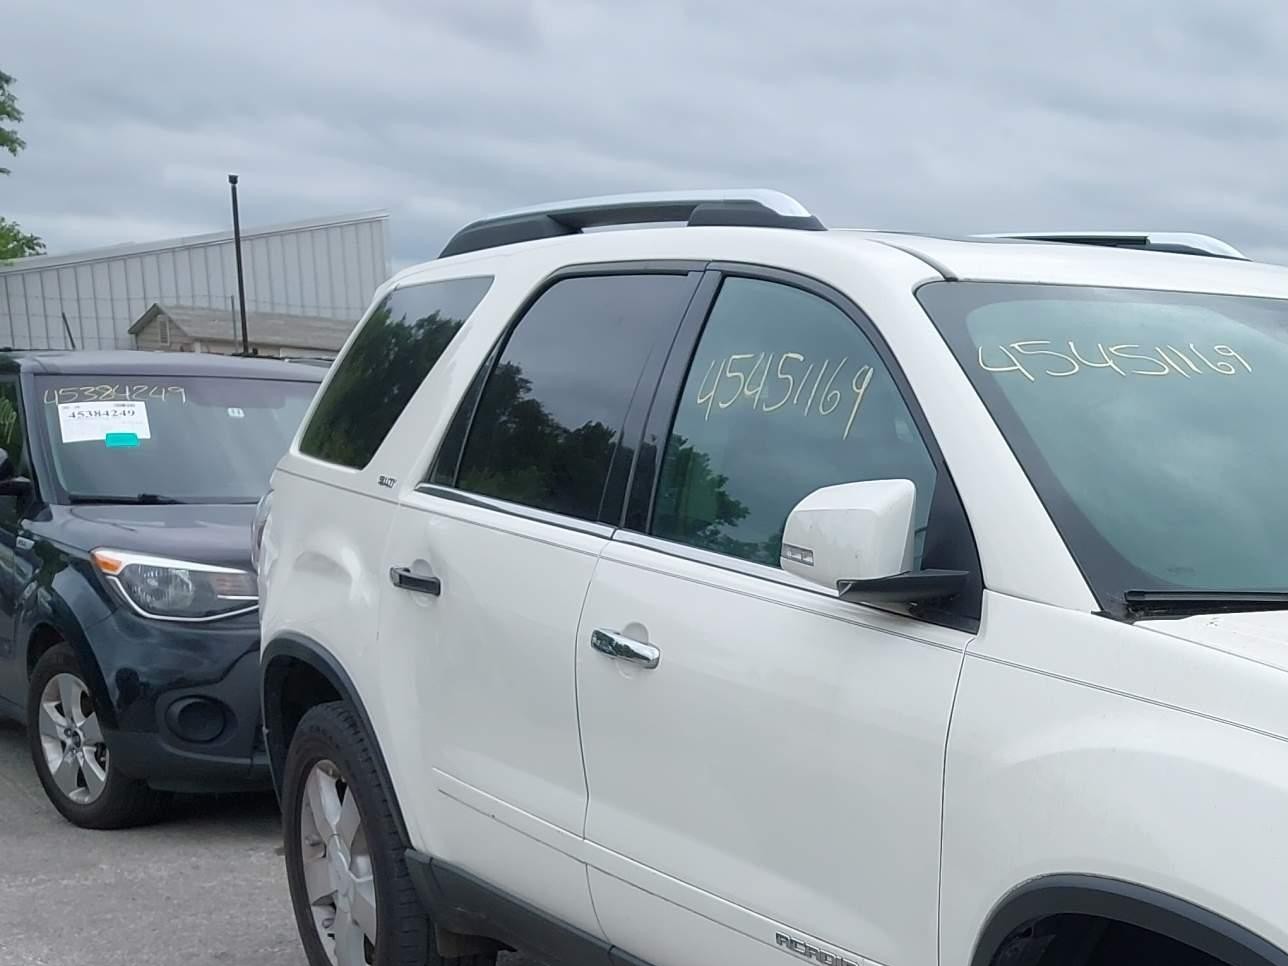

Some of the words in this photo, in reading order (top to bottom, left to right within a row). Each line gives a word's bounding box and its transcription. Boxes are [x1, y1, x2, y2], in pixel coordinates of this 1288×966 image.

[978, 340, 1253, 382] 45451169
[68, 408, 136, 419] 45384249
[696, 352, 875, 440] 45451169
